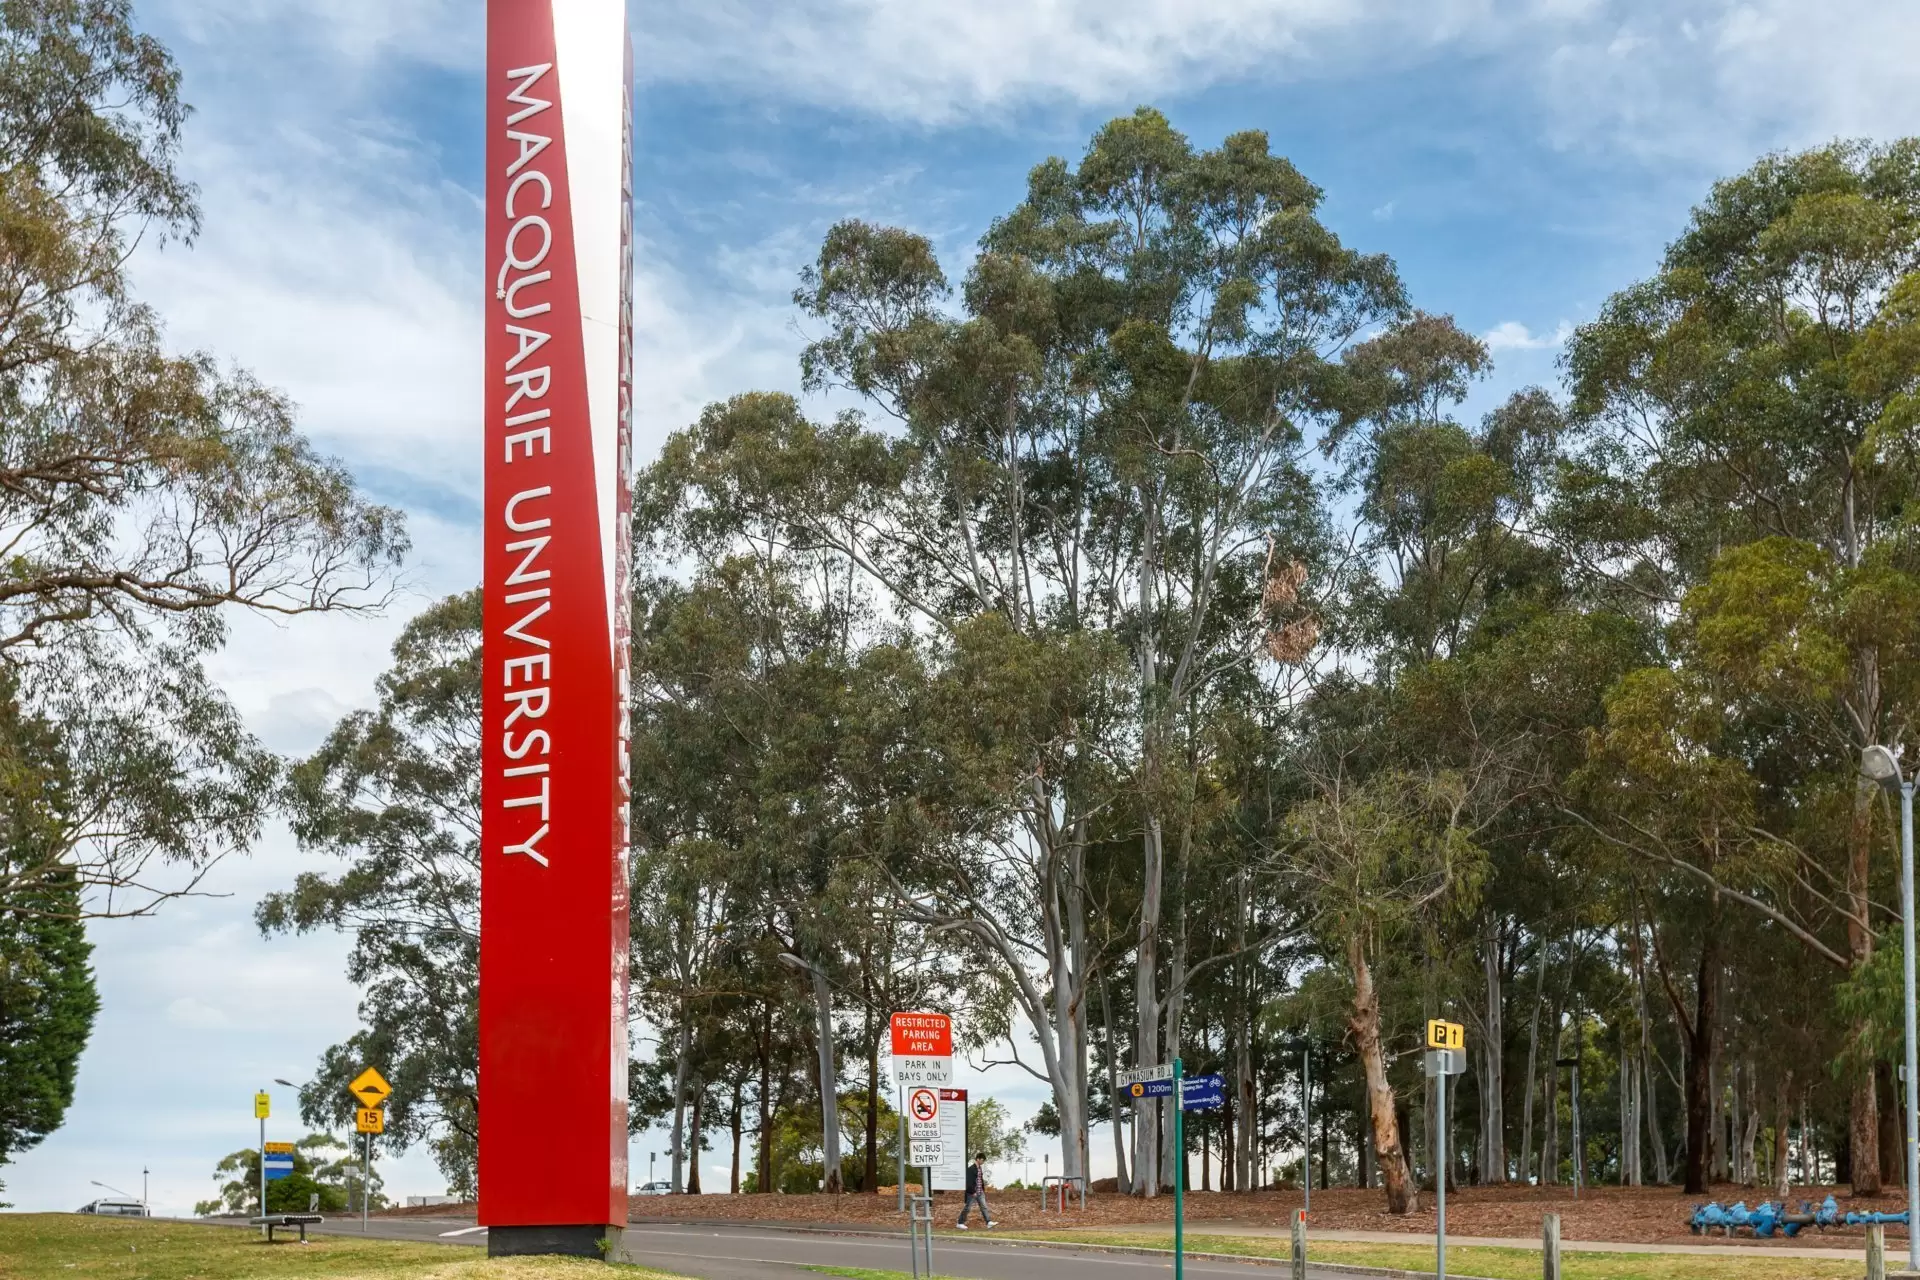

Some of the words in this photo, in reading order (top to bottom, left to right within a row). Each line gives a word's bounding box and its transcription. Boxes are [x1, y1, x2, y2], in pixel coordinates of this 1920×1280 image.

[497, 62, 553, 464] MACQUARIE
[502, 485, 552, 868] UNIVERSITY
[895, 1017, 946, 1028] RESTRICTED
[902, 1029, 940, 1040] PARKING
[1436, 1027, 1445, 1041] P
[911, 1041, 934, 1052] AREA
[905, 1060, 927, 1069] PARK
[932, 1060, 941, 1070] IN
[898, 1071, 921, 1081] BAYS
[926, 1072, 948, 1081] ONLY
[1120, 1069, 1154, 1086] GYMNASIUM
[1157, 1066, 1165, 1078] RD
[1147, 1085, 1172, 1093] 1200m
[364, 1111, 378, 1124] 15
[912, 1144, 924, 1153] NO
[925, 1144, 941, 1153] BUS
[915, 1154, 939, 1164] ENTRY
